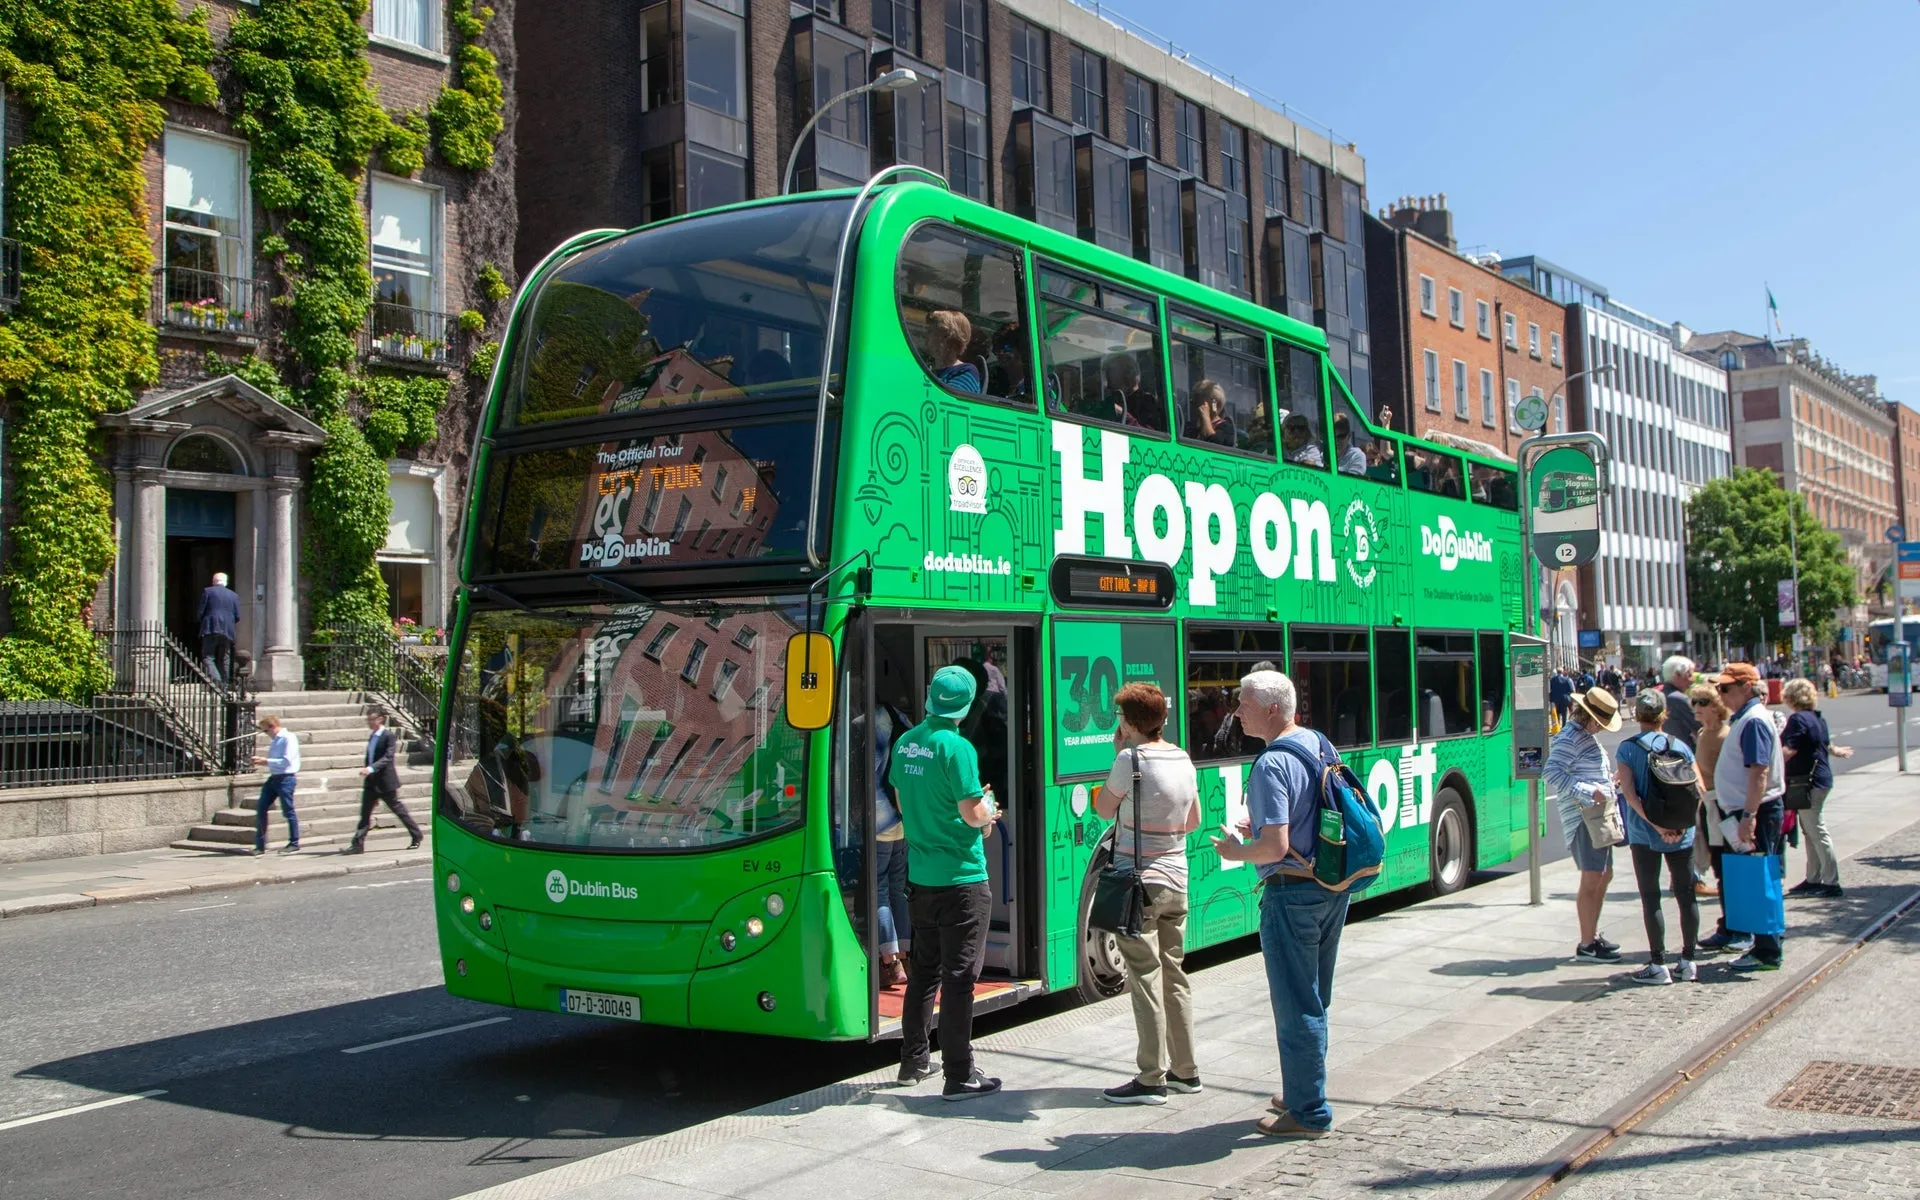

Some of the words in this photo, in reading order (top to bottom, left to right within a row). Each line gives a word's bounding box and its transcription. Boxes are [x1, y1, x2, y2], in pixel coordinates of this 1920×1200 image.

[597, 452, 616, 464] The
[618, 448, 656, 462] Official
[659, 445, 683, 457] Tour
[599, 470, 643, 496] CITY
[650, 464, 702, 490] TOUR
[1051, 420, 1237, 606] Hop
[1250, 492, 1337, 582] on
[1344, 498, 1364, 537] OFFICIAL
[1365, 505, 1379, 543] TOUR
[1561, 548, 1572, 557] 12
[924, 551, 1011, 575] dodublin.ie
[1346, 558, 1364, 588] SINCE
[1100, 576, 1113, 591] CITY
[1114, 577, 1130, 592] TOUR
[1061, 656, 1118, 733] 30
[1064, 737, 1080, 746] YEAR
[904, 764, 924, 776] TEAM
[1052, 831, 1062, 842] EV
[743, 860, 760, 872] EV
[765, 861, 781, 873] 49
[570, 879, 610, 897] Dublin
[612, 882, 638, 899] Bus
[568, 995, 632, 1017] 07-D-30049
